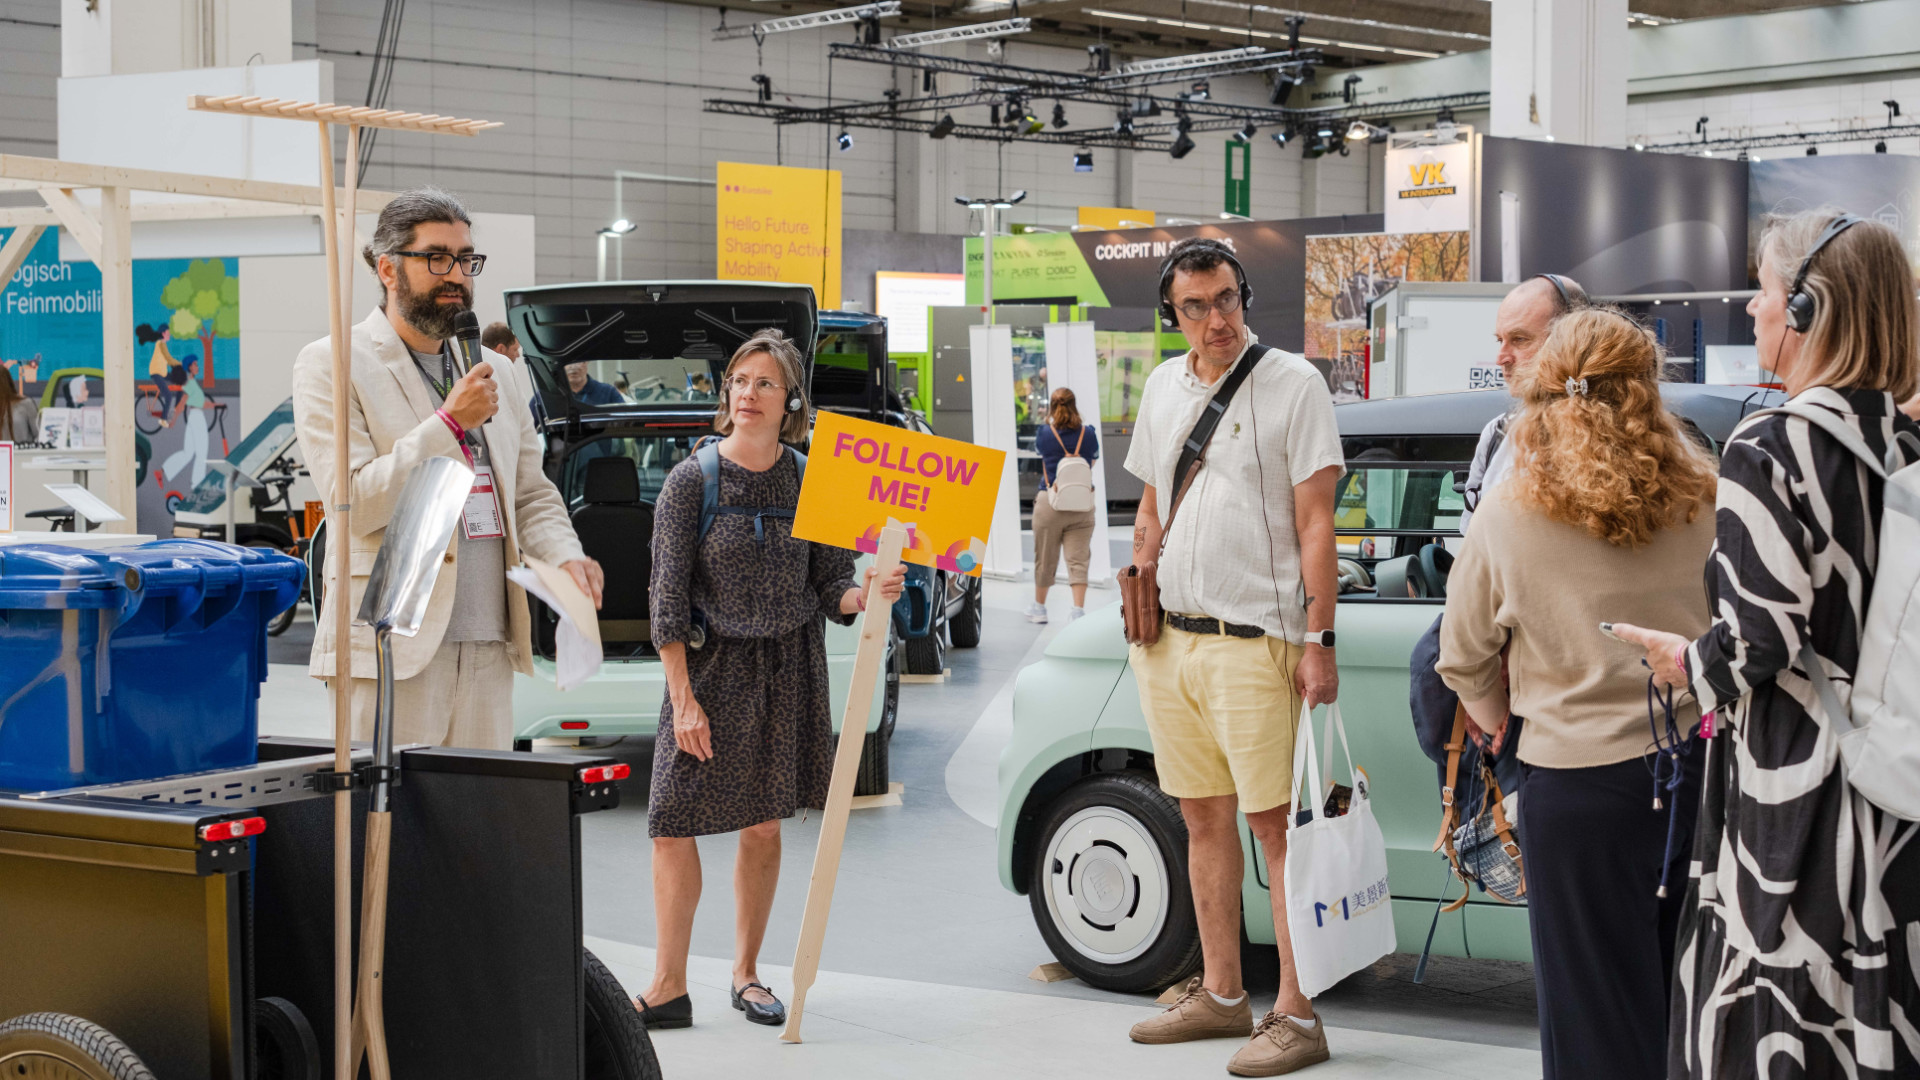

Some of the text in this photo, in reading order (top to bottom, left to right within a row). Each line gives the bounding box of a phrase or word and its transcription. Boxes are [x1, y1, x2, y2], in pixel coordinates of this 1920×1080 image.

[1409, 161, 1446, 186] VK
[724, 215, 761, 232] Hello
[725, 237, 831, 260] Shaping Active
[1095, 242, 1151, 260] COCKPIT
[1153, 241, 1167, 257] IN
[6, 289, 102, 314] Feinmobili
[833, 432, 980, 486] FOLLOW
[868, 475, 931, 512] ME!
[1351, 875, 1390, 912] 美景新
